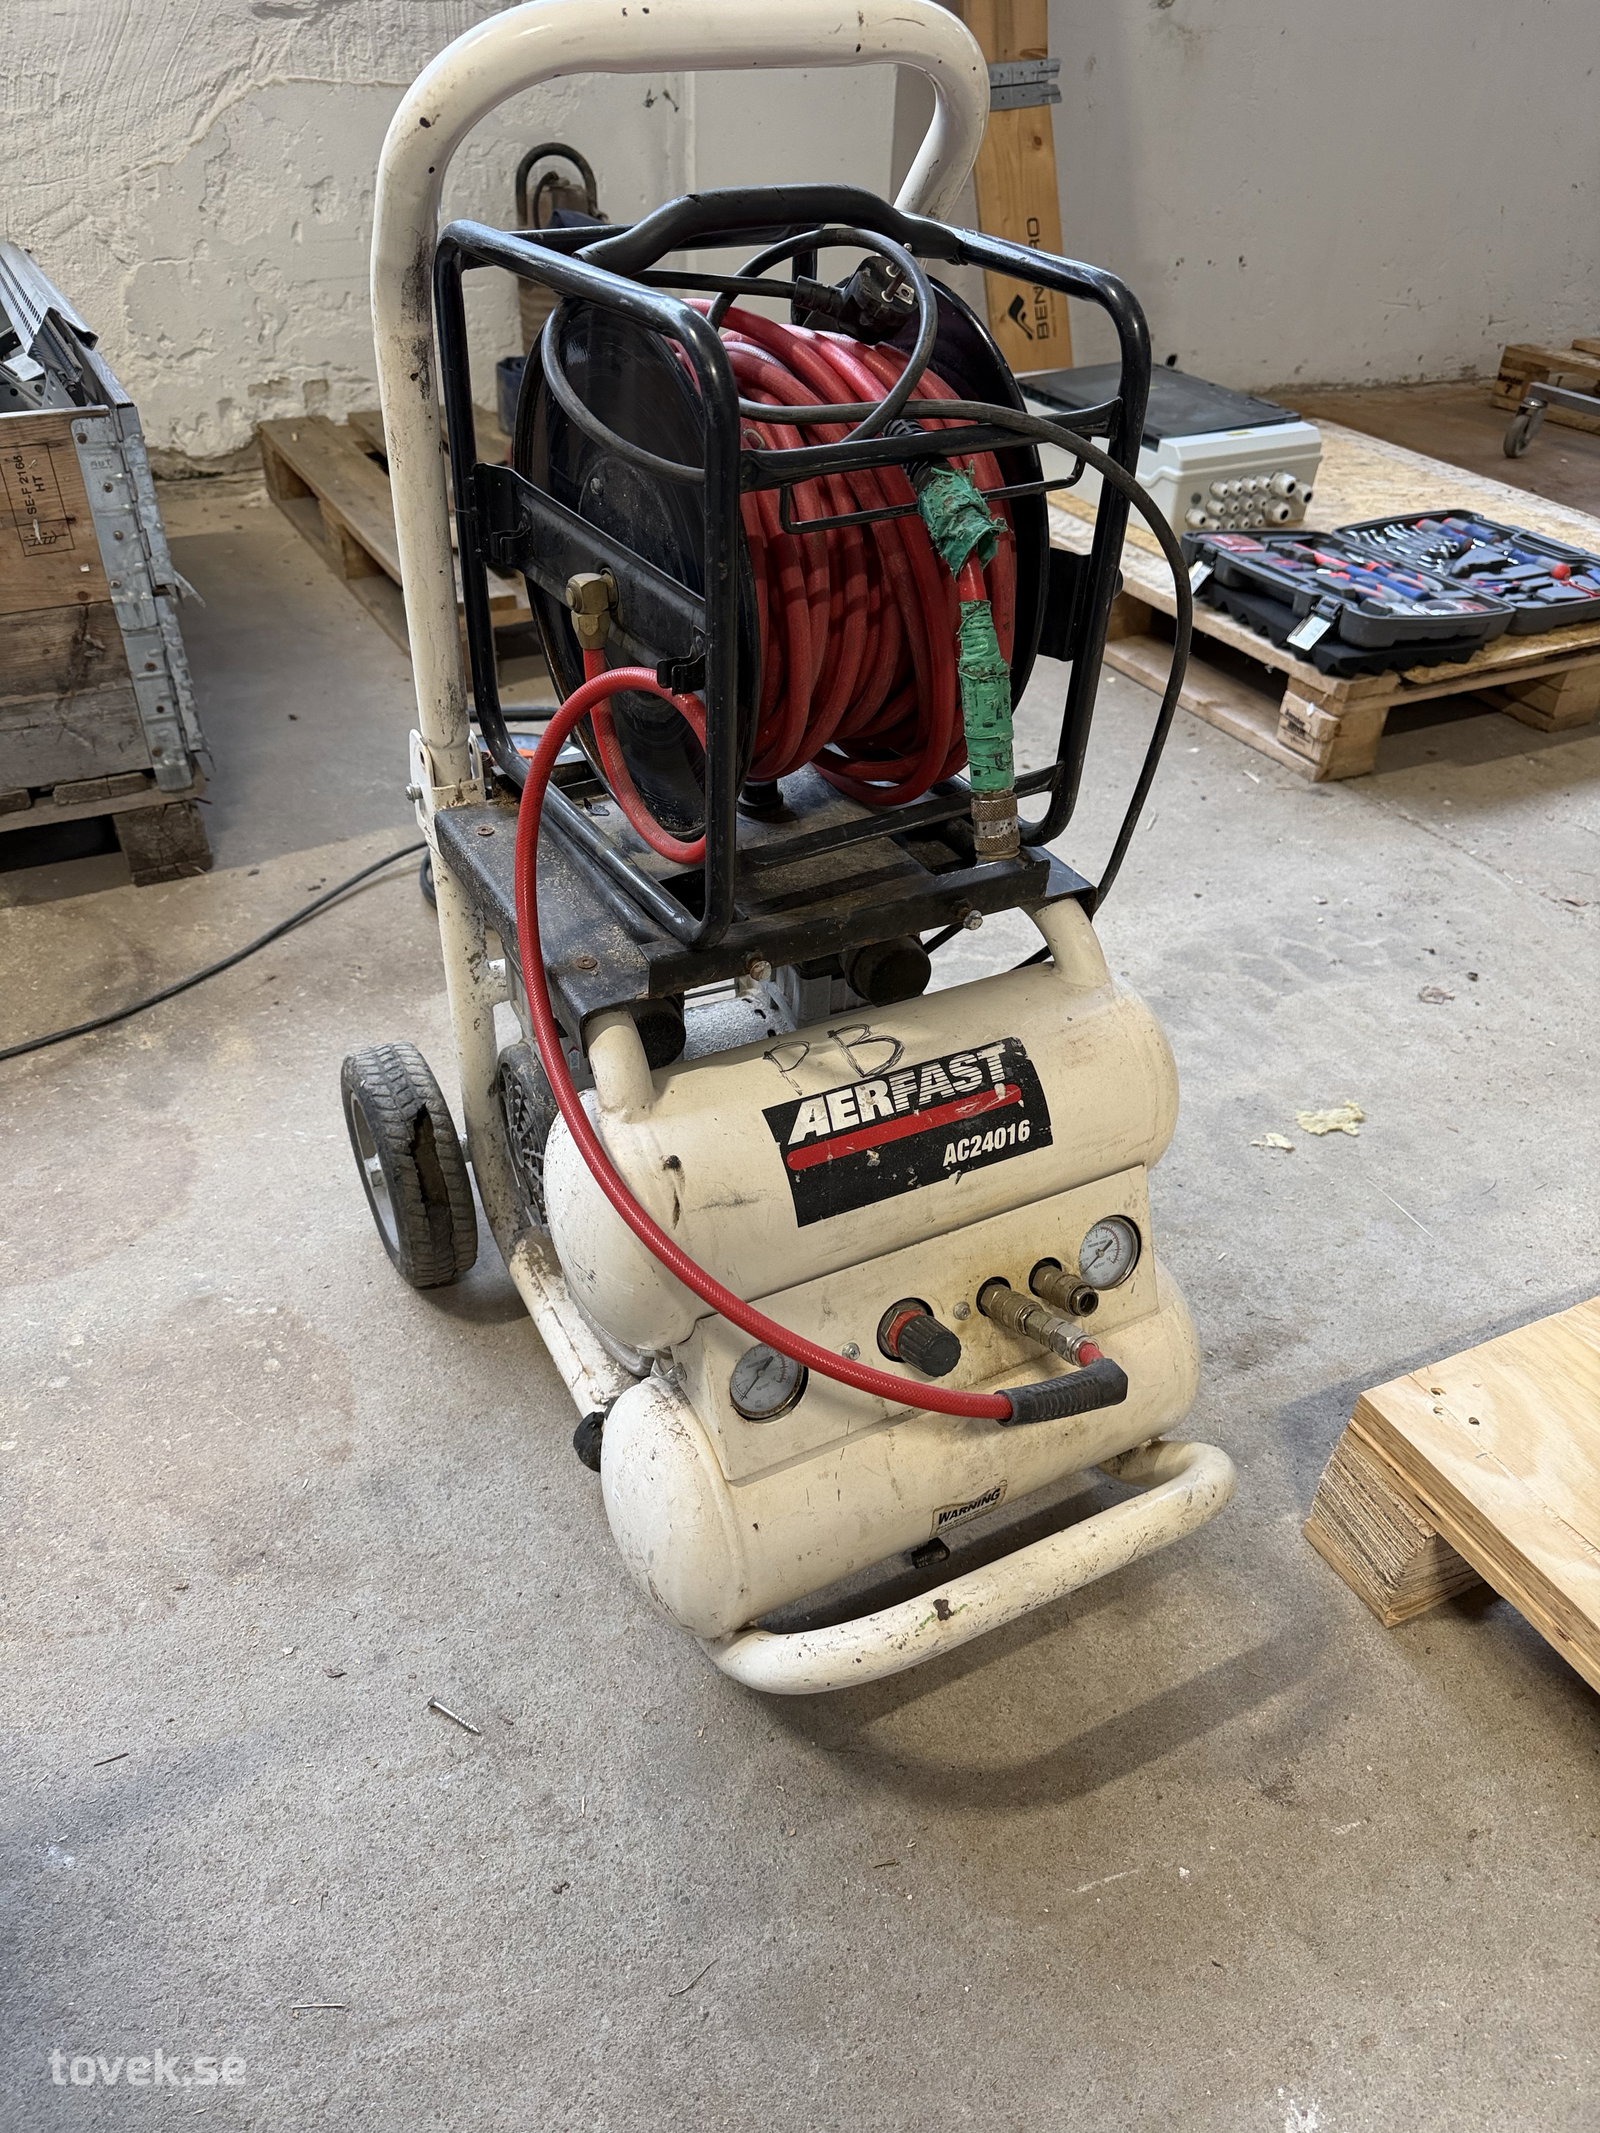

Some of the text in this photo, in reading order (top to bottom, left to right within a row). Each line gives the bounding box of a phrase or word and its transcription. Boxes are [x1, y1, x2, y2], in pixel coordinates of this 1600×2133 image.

[21, 487, 37, 515] SE-F
[32, 475, 46, 492] HT
[788, 1043, 1007, 1145] AERFAST
[942, 1119, 1031, 1168] AC24016
[938, 1487, 1001, 1526] WARNING
